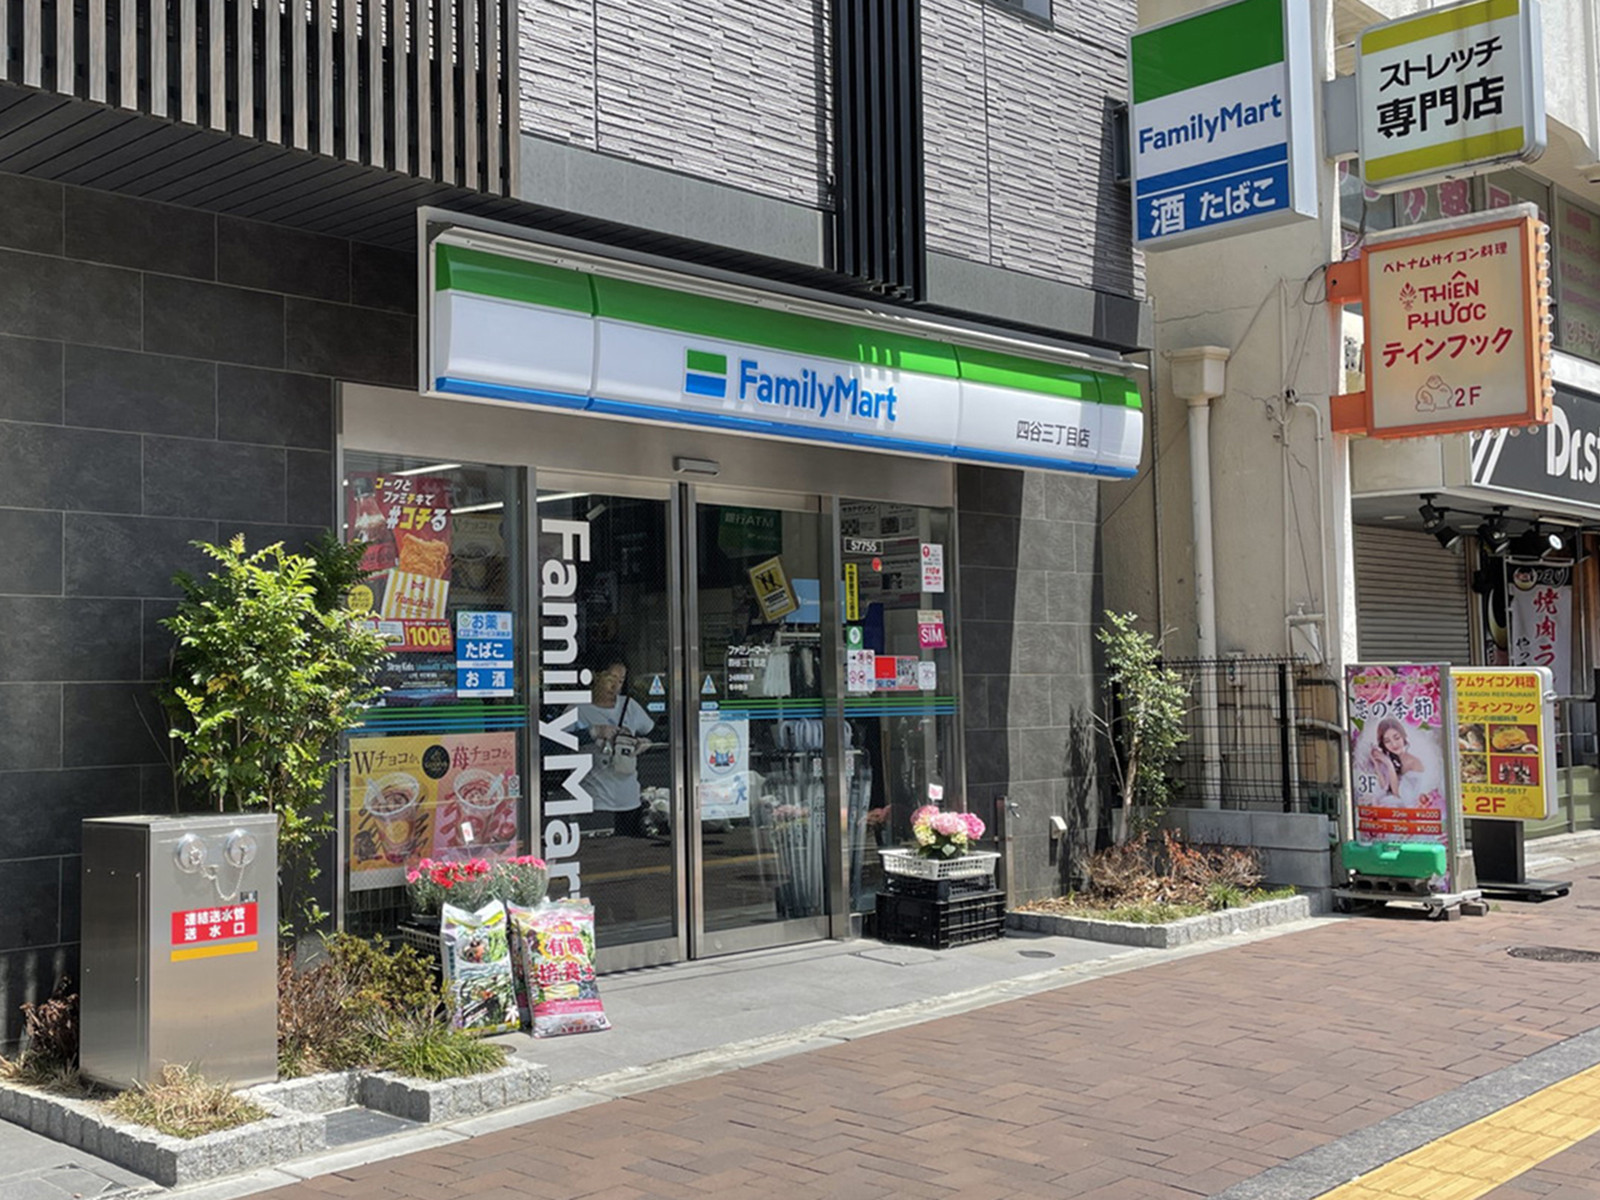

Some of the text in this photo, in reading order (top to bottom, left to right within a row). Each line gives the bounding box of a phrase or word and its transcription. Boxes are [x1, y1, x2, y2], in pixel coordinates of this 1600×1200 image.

[1379, 36, 1503, 92] ストレッチ
[1376, 75, 1505, 139] 専門店
[1139, 94, 1282, 154] FamilyMart
[1150, 177, 1276, 236] 酒 たばこ
[1382, 327, 1513, 368] ティンフック
[739, 359, 897, 422] FamilyMart
[1454, 386, 1482, 407] 2F
[1016, 420, 1090, 448] 四谷三丁目店
[1547, 404, 1600, 484] Dr.s
[375, 477, 412, 491] コークと
[383, 491, 436, 506] ファミチキで
[386, 505, 448, 532] #コチる
[921, 628, 943, 644] SIM
[465, 642, 505, 658] たばこ
[538, 518, 593, 899] FamilyMar
[1355, 697, 1432, 720] 恋の季節
[1469, 701, 1535, 714] ティンフック
[1358, 775, 1377, 794] 3F
[1475, 796, 1506, 813] 2F
[549, 936, 586, 956] 有機
[539, 961, 596, 984] 培養土
